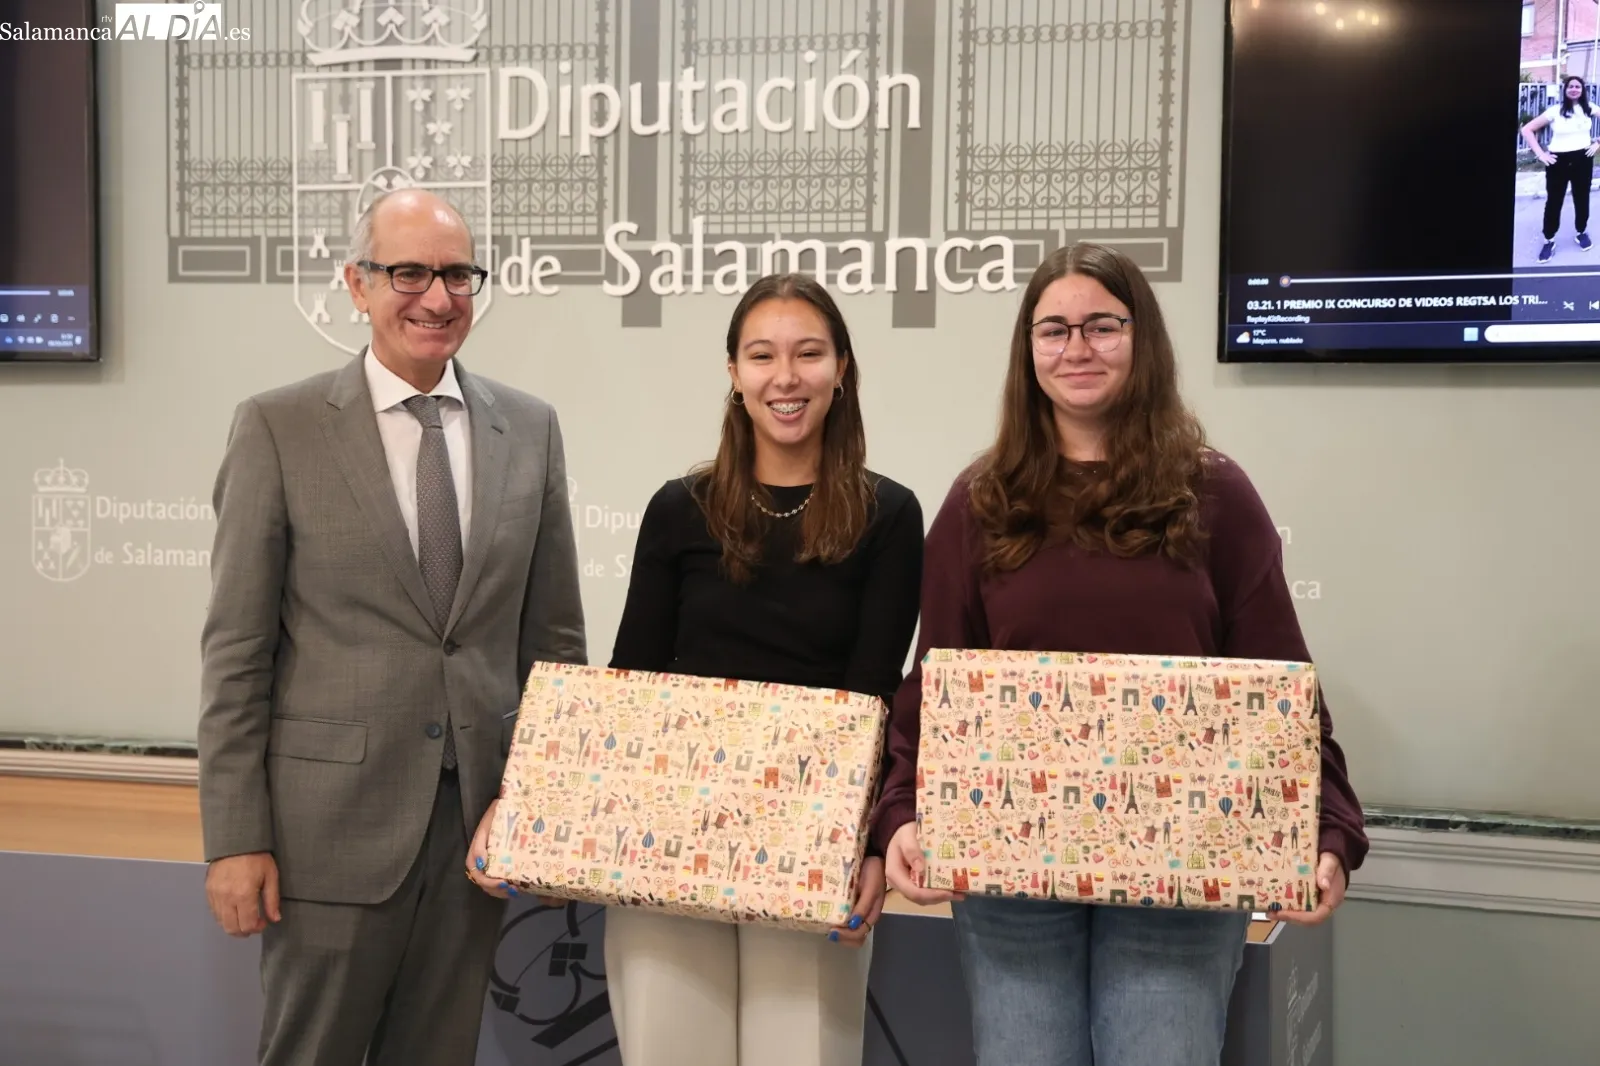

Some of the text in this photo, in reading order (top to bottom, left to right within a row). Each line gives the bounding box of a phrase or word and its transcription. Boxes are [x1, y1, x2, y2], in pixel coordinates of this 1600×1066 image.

[497, 50, 922, 157] Diputación
[498, 215, 1018, 298] de Salamanca
[1246, 299, 1275, 311] 03.21.
[1276, 299, 1282, 310] 1
[1283, 299, 1323, 310] PREMIO
[1325, 299, 1337, 309] IX
[1337, 297, 1397, 309] CONCURSO
[1398, 297, 1413, 308] DE
[1414, 296, 1454, 308] VIDEOS
[1456, 296, 1497, 307] REGTSA
[1499, 295, 1520, 306] LOS
[95, 495, 213, 525] Diputación
[94, 541, 211, 567] de Salaman
[583, 558, 606, 578] de
[1262, 785, 1280, 798] PARIS
[1183, 884, 1202, 898] PARIS
